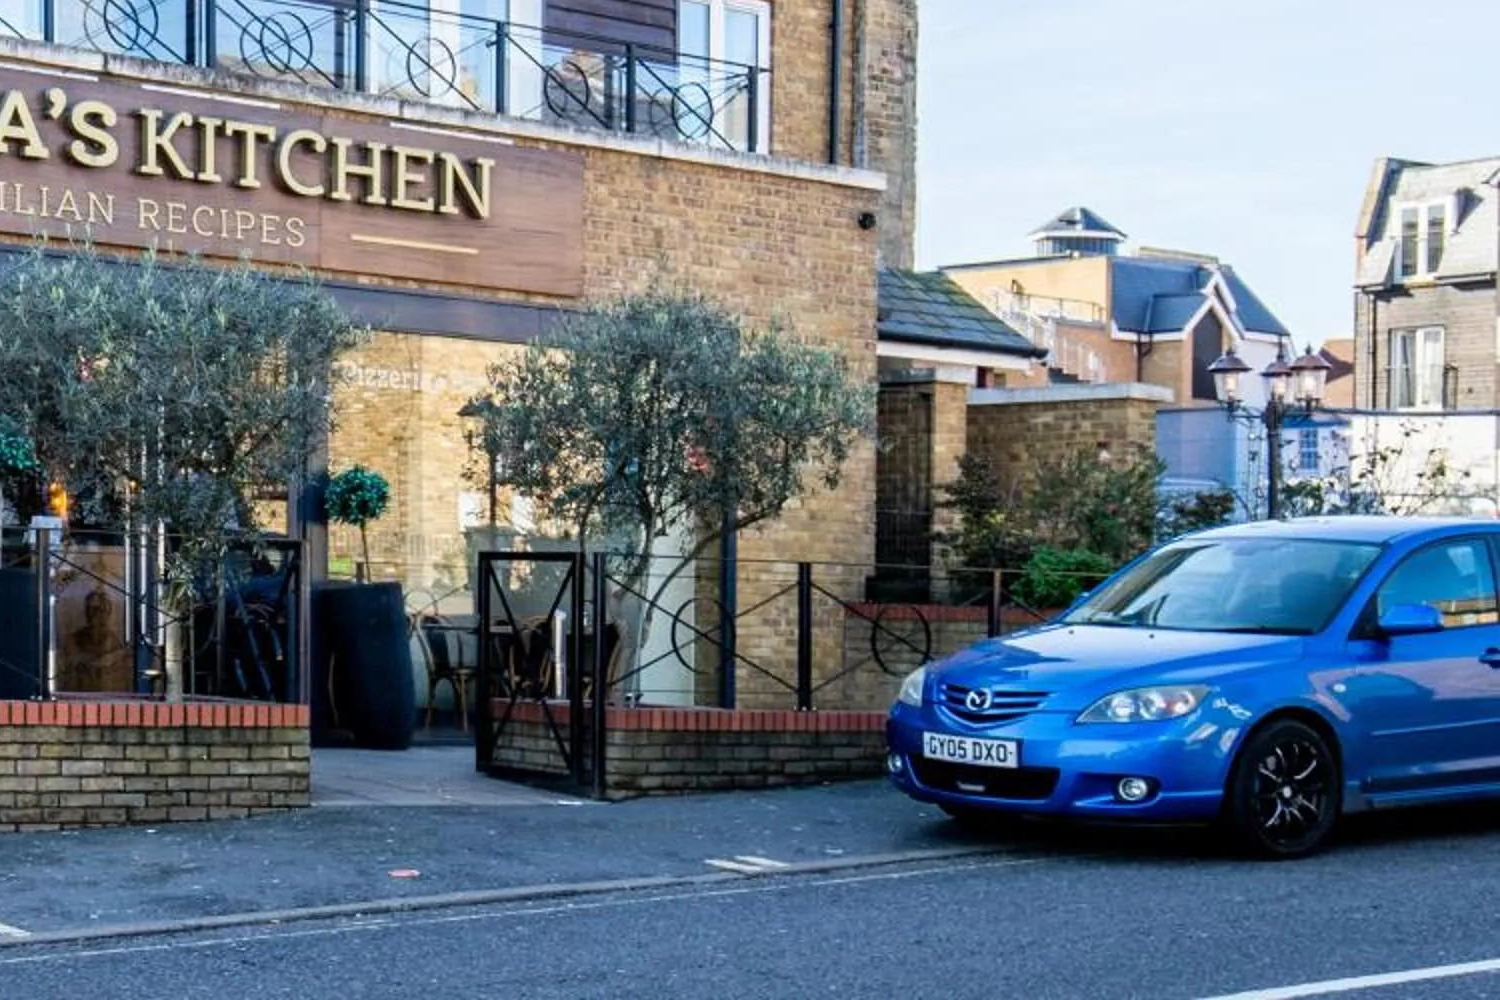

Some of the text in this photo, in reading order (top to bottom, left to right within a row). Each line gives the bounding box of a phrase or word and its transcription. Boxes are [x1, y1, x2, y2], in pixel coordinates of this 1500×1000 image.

[136, 107, 496, 220] KITCHEN
[137, 198, 306, 248] RECIPES
[929, 735, 1008, 762] GY05 DXO
